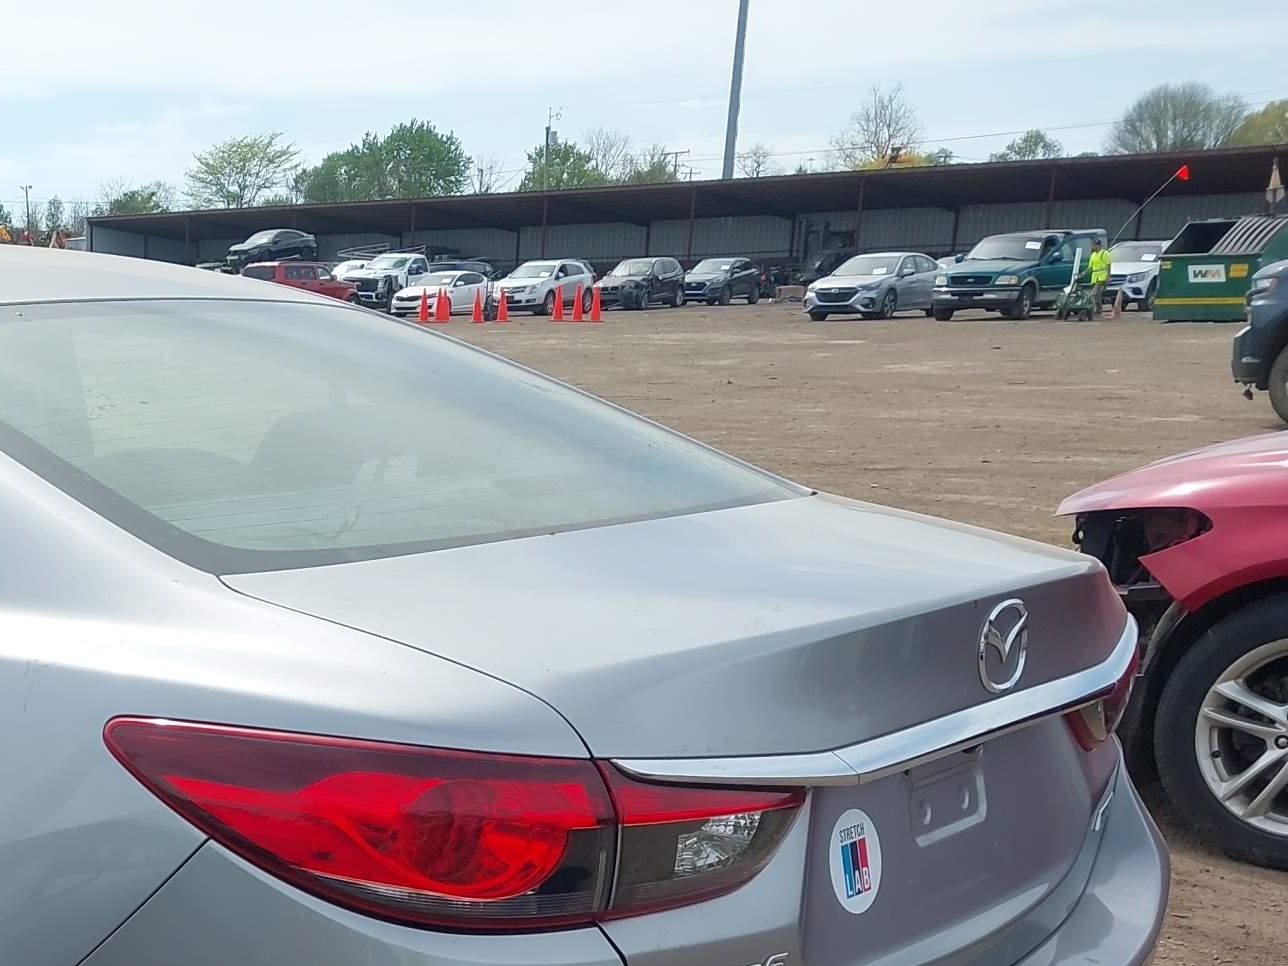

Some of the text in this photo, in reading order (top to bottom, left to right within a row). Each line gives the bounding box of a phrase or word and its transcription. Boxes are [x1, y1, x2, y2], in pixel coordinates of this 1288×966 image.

[1193, 269, 1221, 279] WM
[839, 822, 865, 843] STRETCH
[846, 867, 870, 896] LAB
